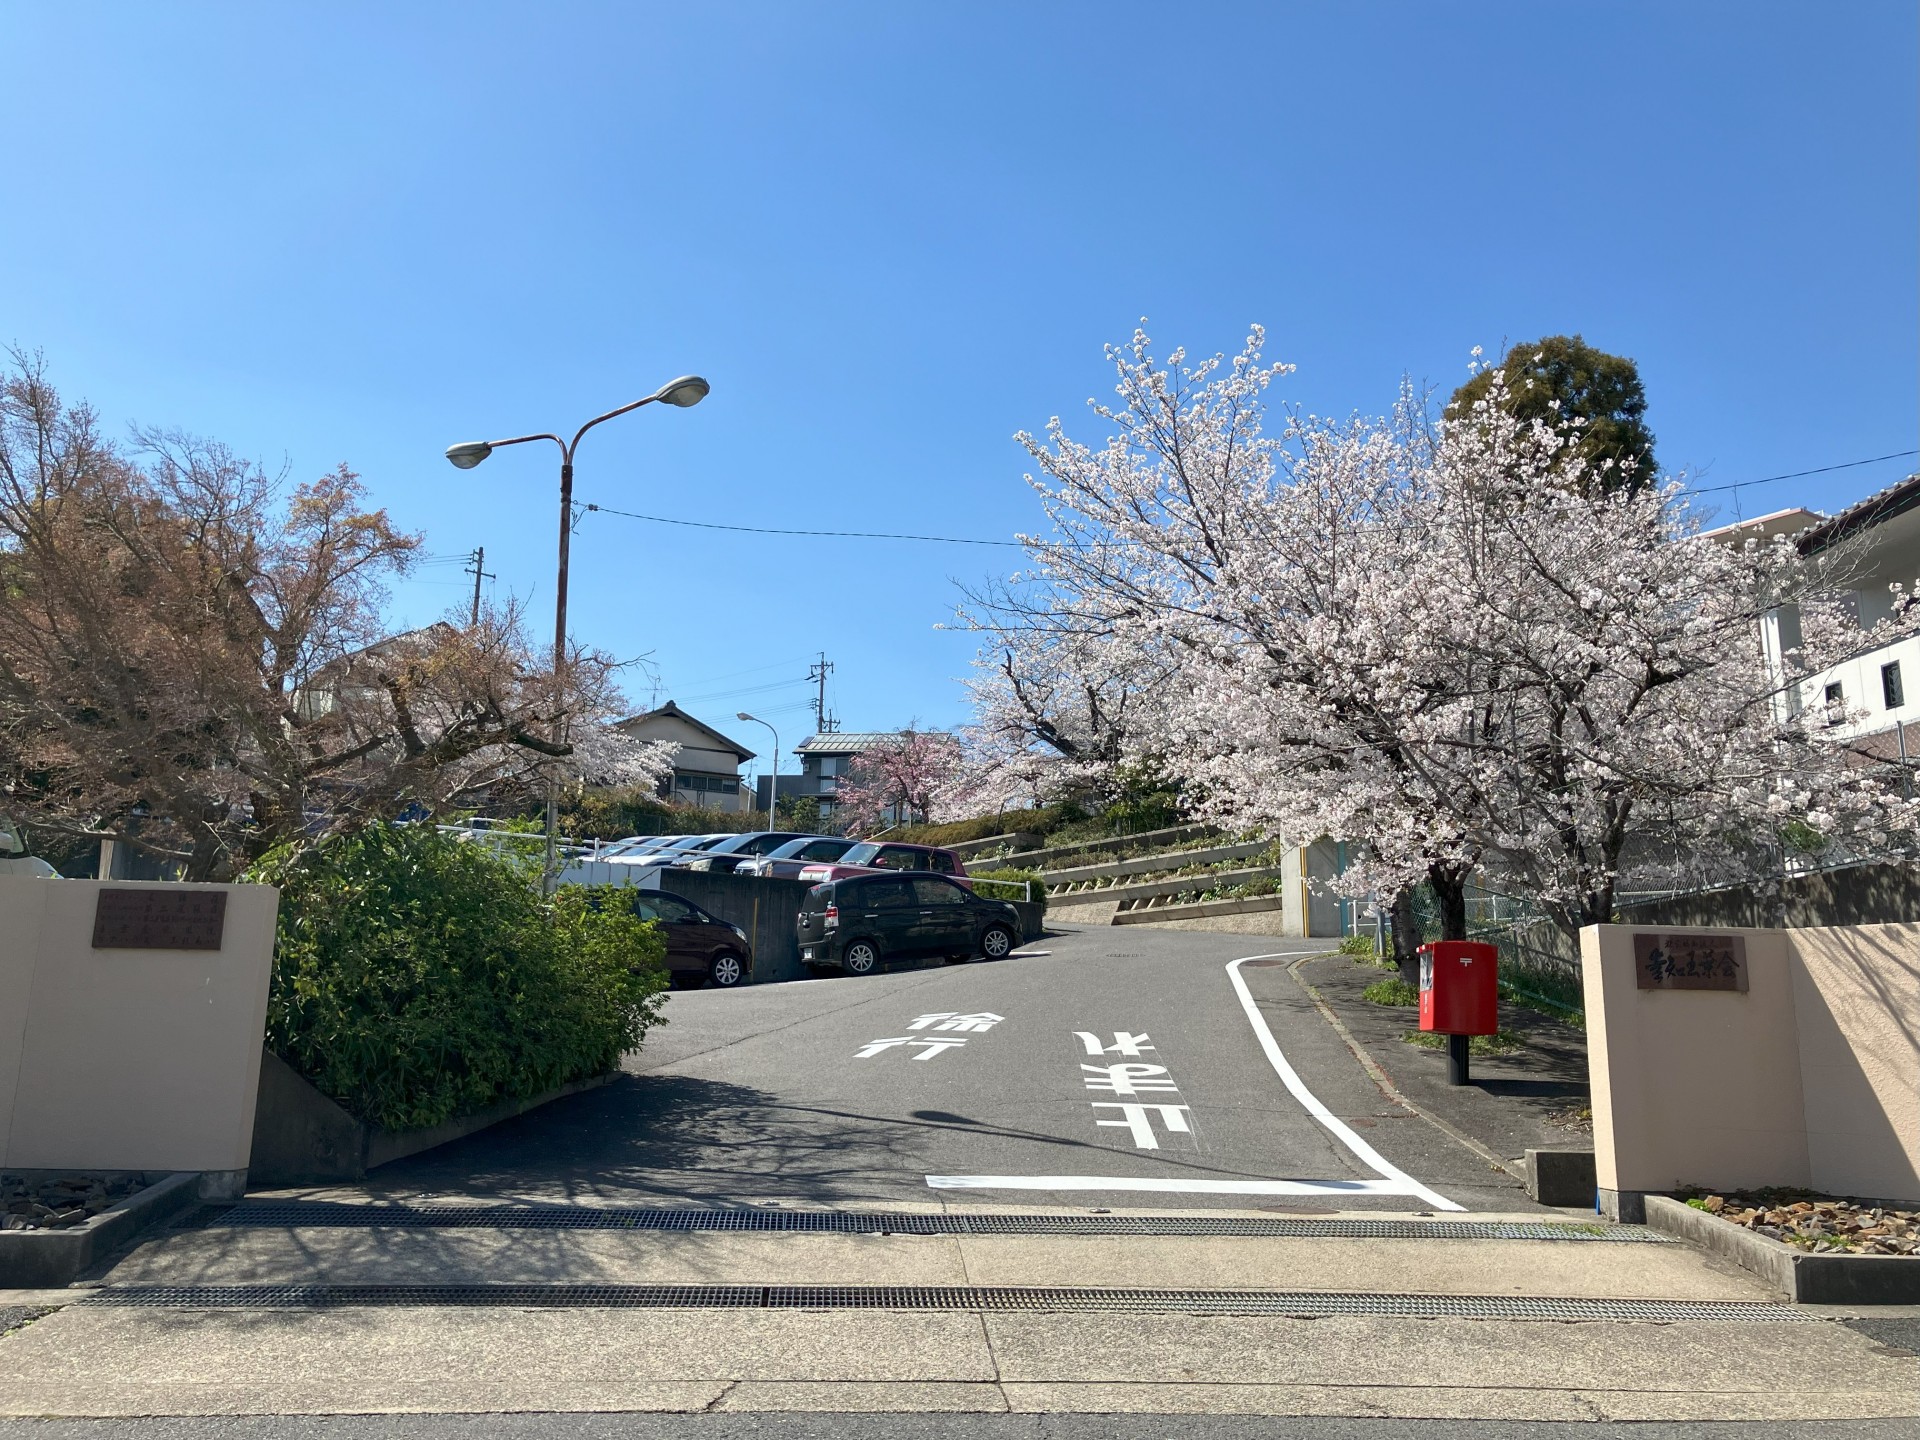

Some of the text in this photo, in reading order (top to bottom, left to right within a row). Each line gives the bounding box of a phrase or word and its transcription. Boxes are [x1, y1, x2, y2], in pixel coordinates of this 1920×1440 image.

[853, 1012, 1005, 1061] 徐行
[1072, 1031, 1190, 1150] 止まれ
